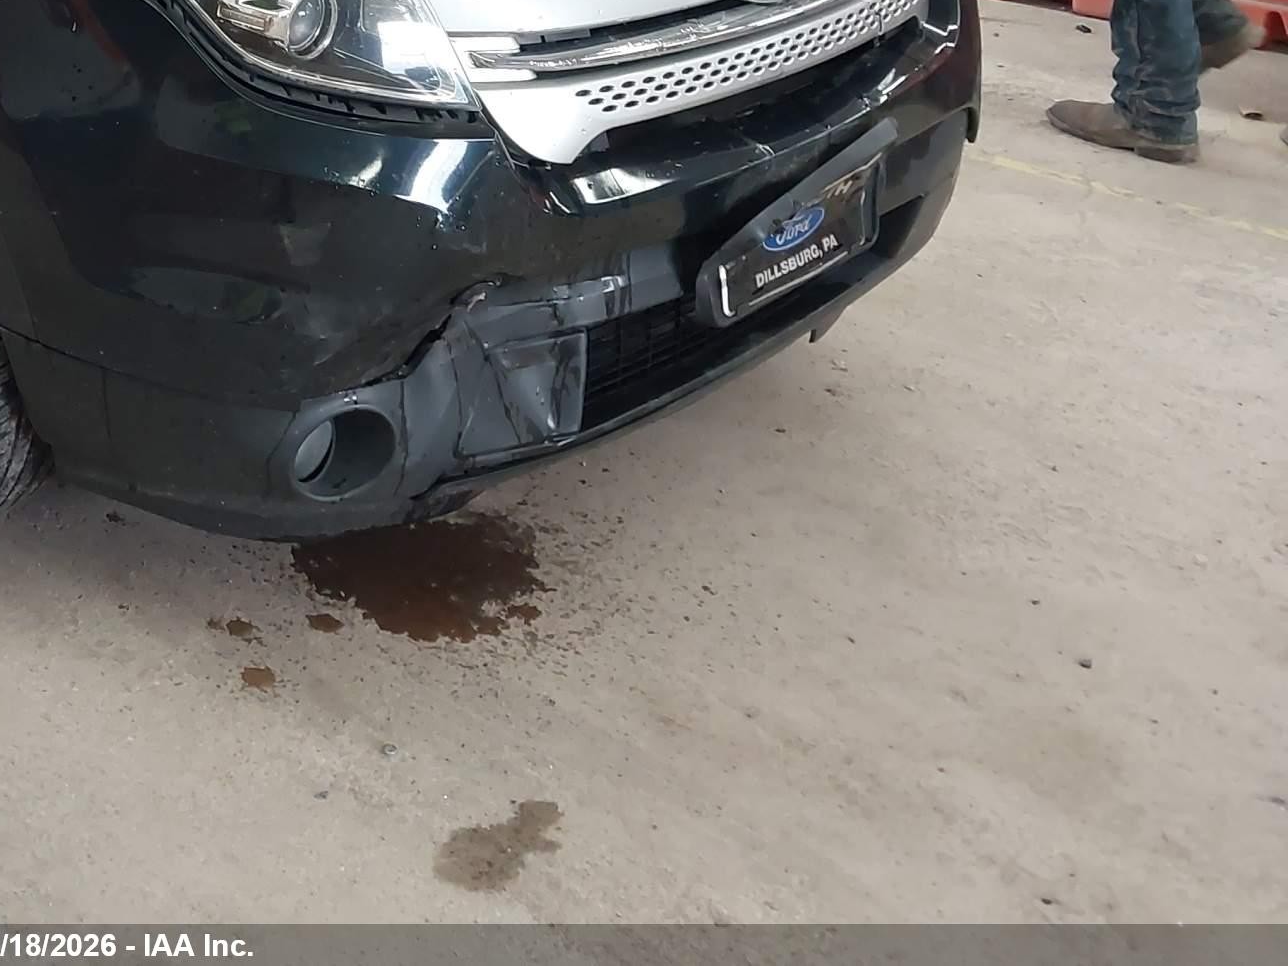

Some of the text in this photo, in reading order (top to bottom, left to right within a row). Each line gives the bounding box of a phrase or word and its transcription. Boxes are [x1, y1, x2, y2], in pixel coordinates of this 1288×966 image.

[774, 212, 814, 246] Ford
[755, 234, 839, 288] DILLSBURG, PA
